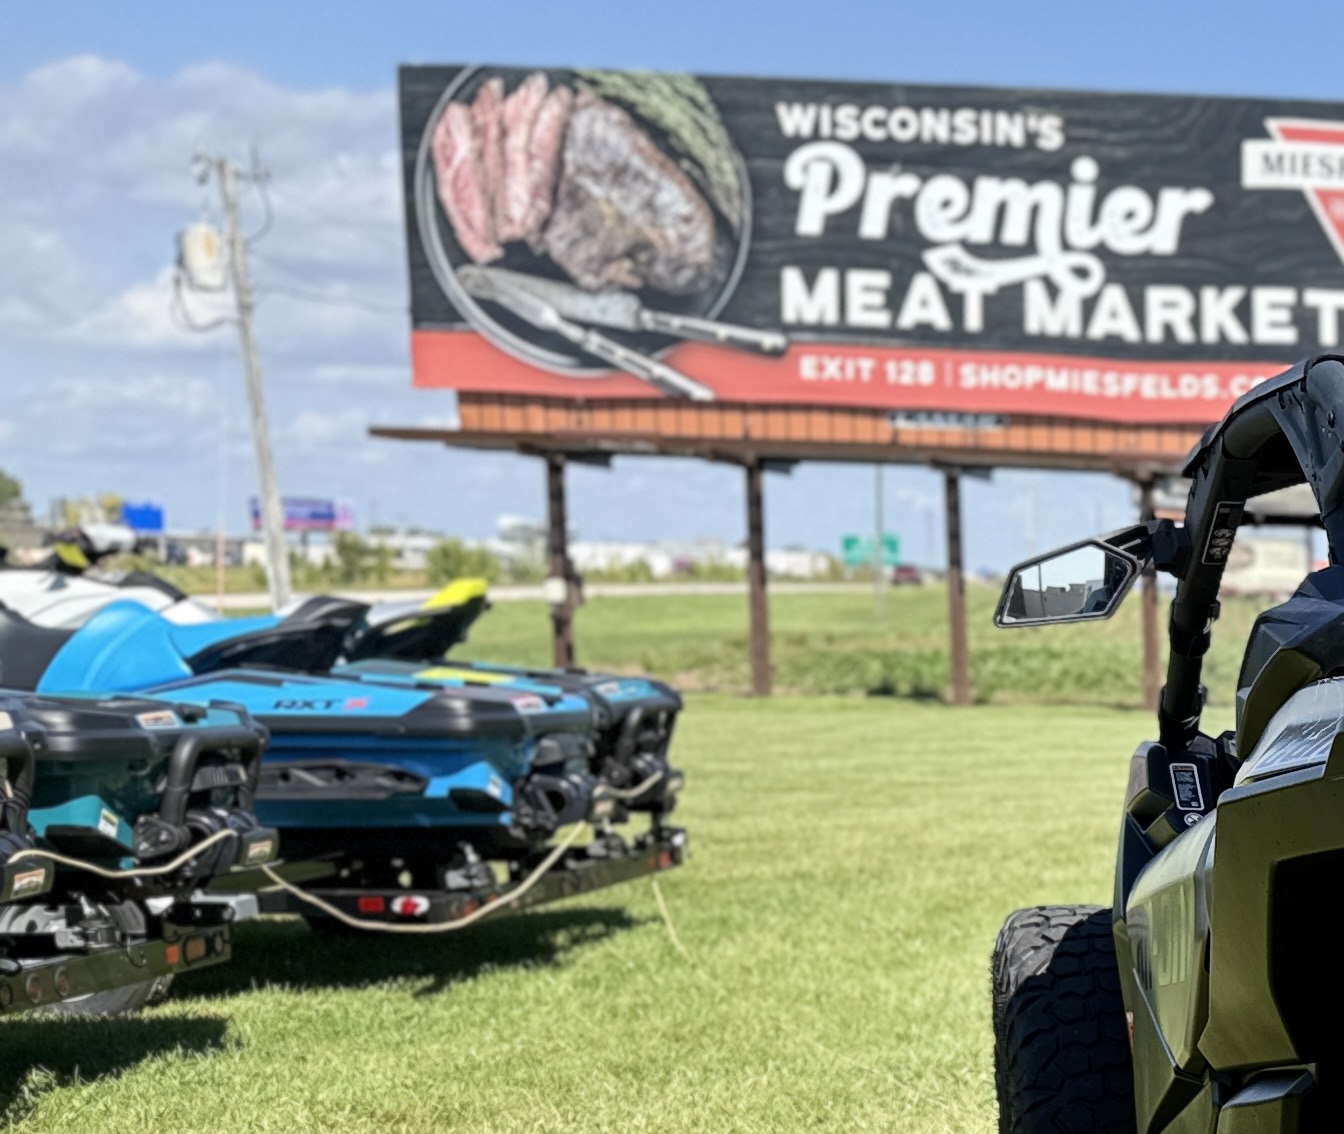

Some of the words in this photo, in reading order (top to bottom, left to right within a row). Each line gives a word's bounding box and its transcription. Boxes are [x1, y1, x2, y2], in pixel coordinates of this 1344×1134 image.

[775, 101, 1065, 151] WISCONSIN'S
[783, 140, 1214, 297] Premier
[780, 266, 999, 333] MEAT
[799, 355, 876, 382] EXIT
[884, 359, 936, 386] 128
